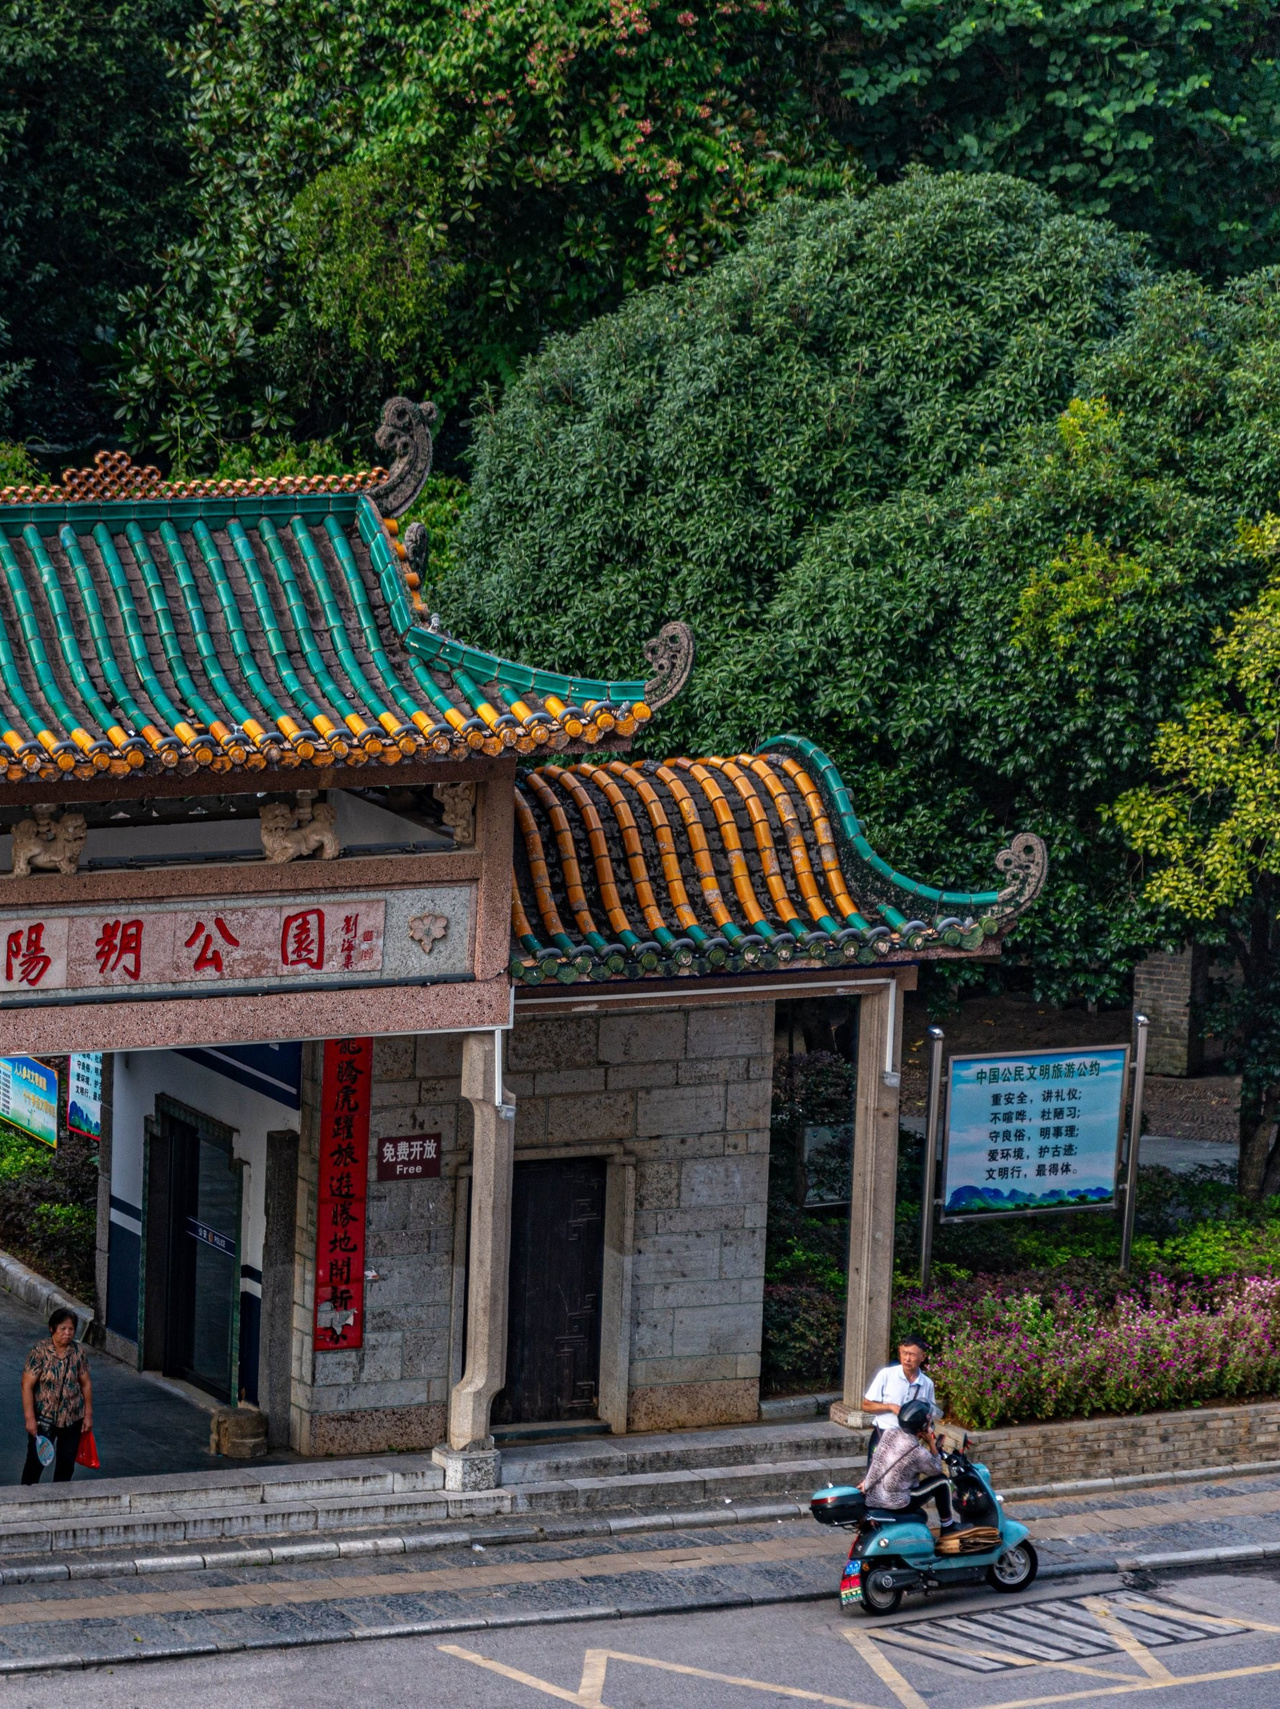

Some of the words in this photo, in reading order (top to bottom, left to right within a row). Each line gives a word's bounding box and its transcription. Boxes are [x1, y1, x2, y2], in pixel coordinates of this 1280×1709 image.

[5, 908, 325, 987] 陽朔公園
[976, 1060, 1101, 1086] 中国公民文明旅游公约
[382, 1139, 437, 1163] 免费开放
[396, 1164, 423, 1175] Free
[213, 1235, 226, 1248] POLICE
